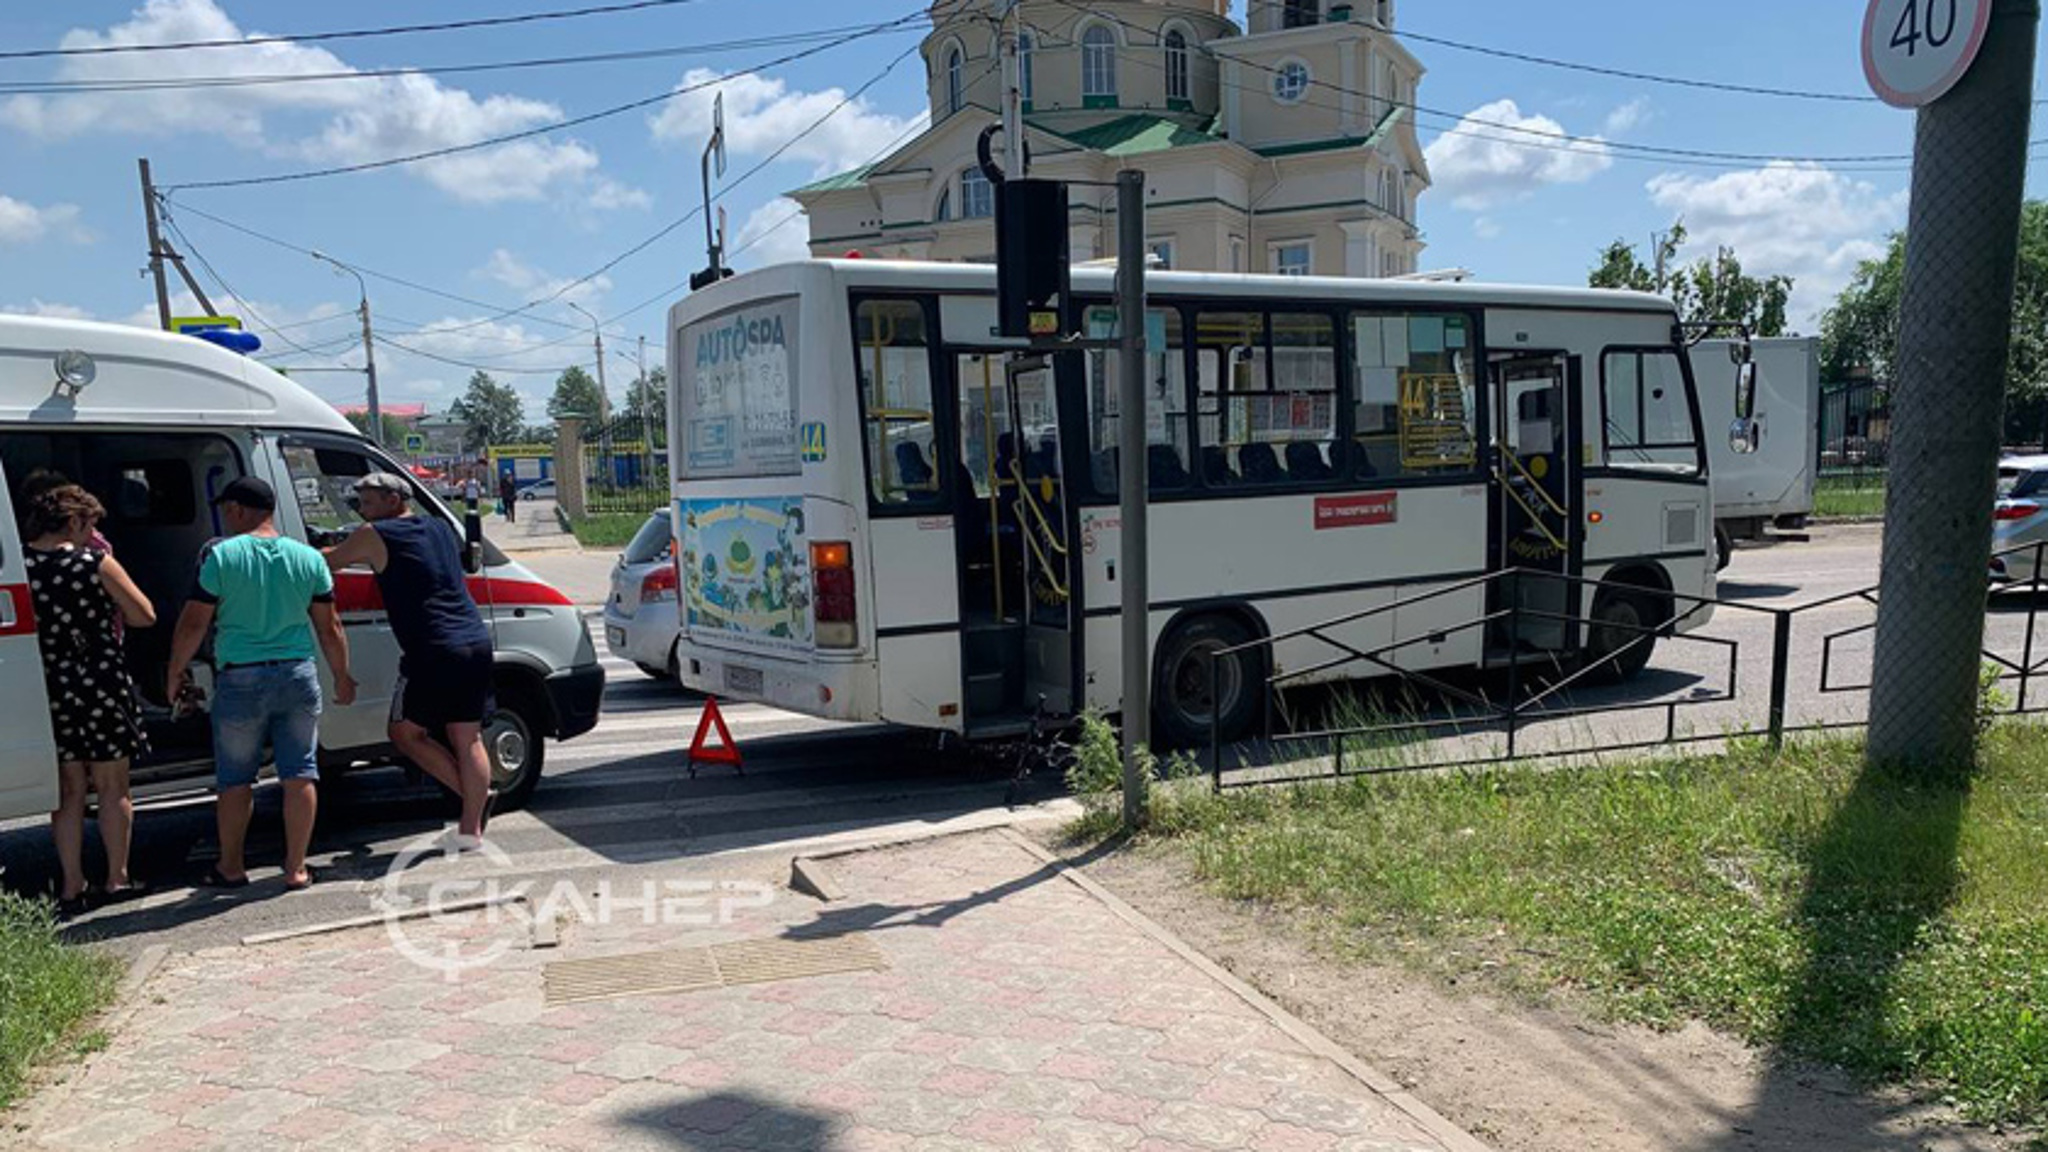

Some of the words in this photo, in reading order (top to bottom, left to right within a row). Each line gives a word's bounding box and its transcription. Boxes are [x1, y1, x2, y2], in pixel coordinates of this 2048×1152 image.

[1889, 0, 1956, 57] 40
[1402, 378, 1426, 418] 44
[802, 423, 824, 461] 44
